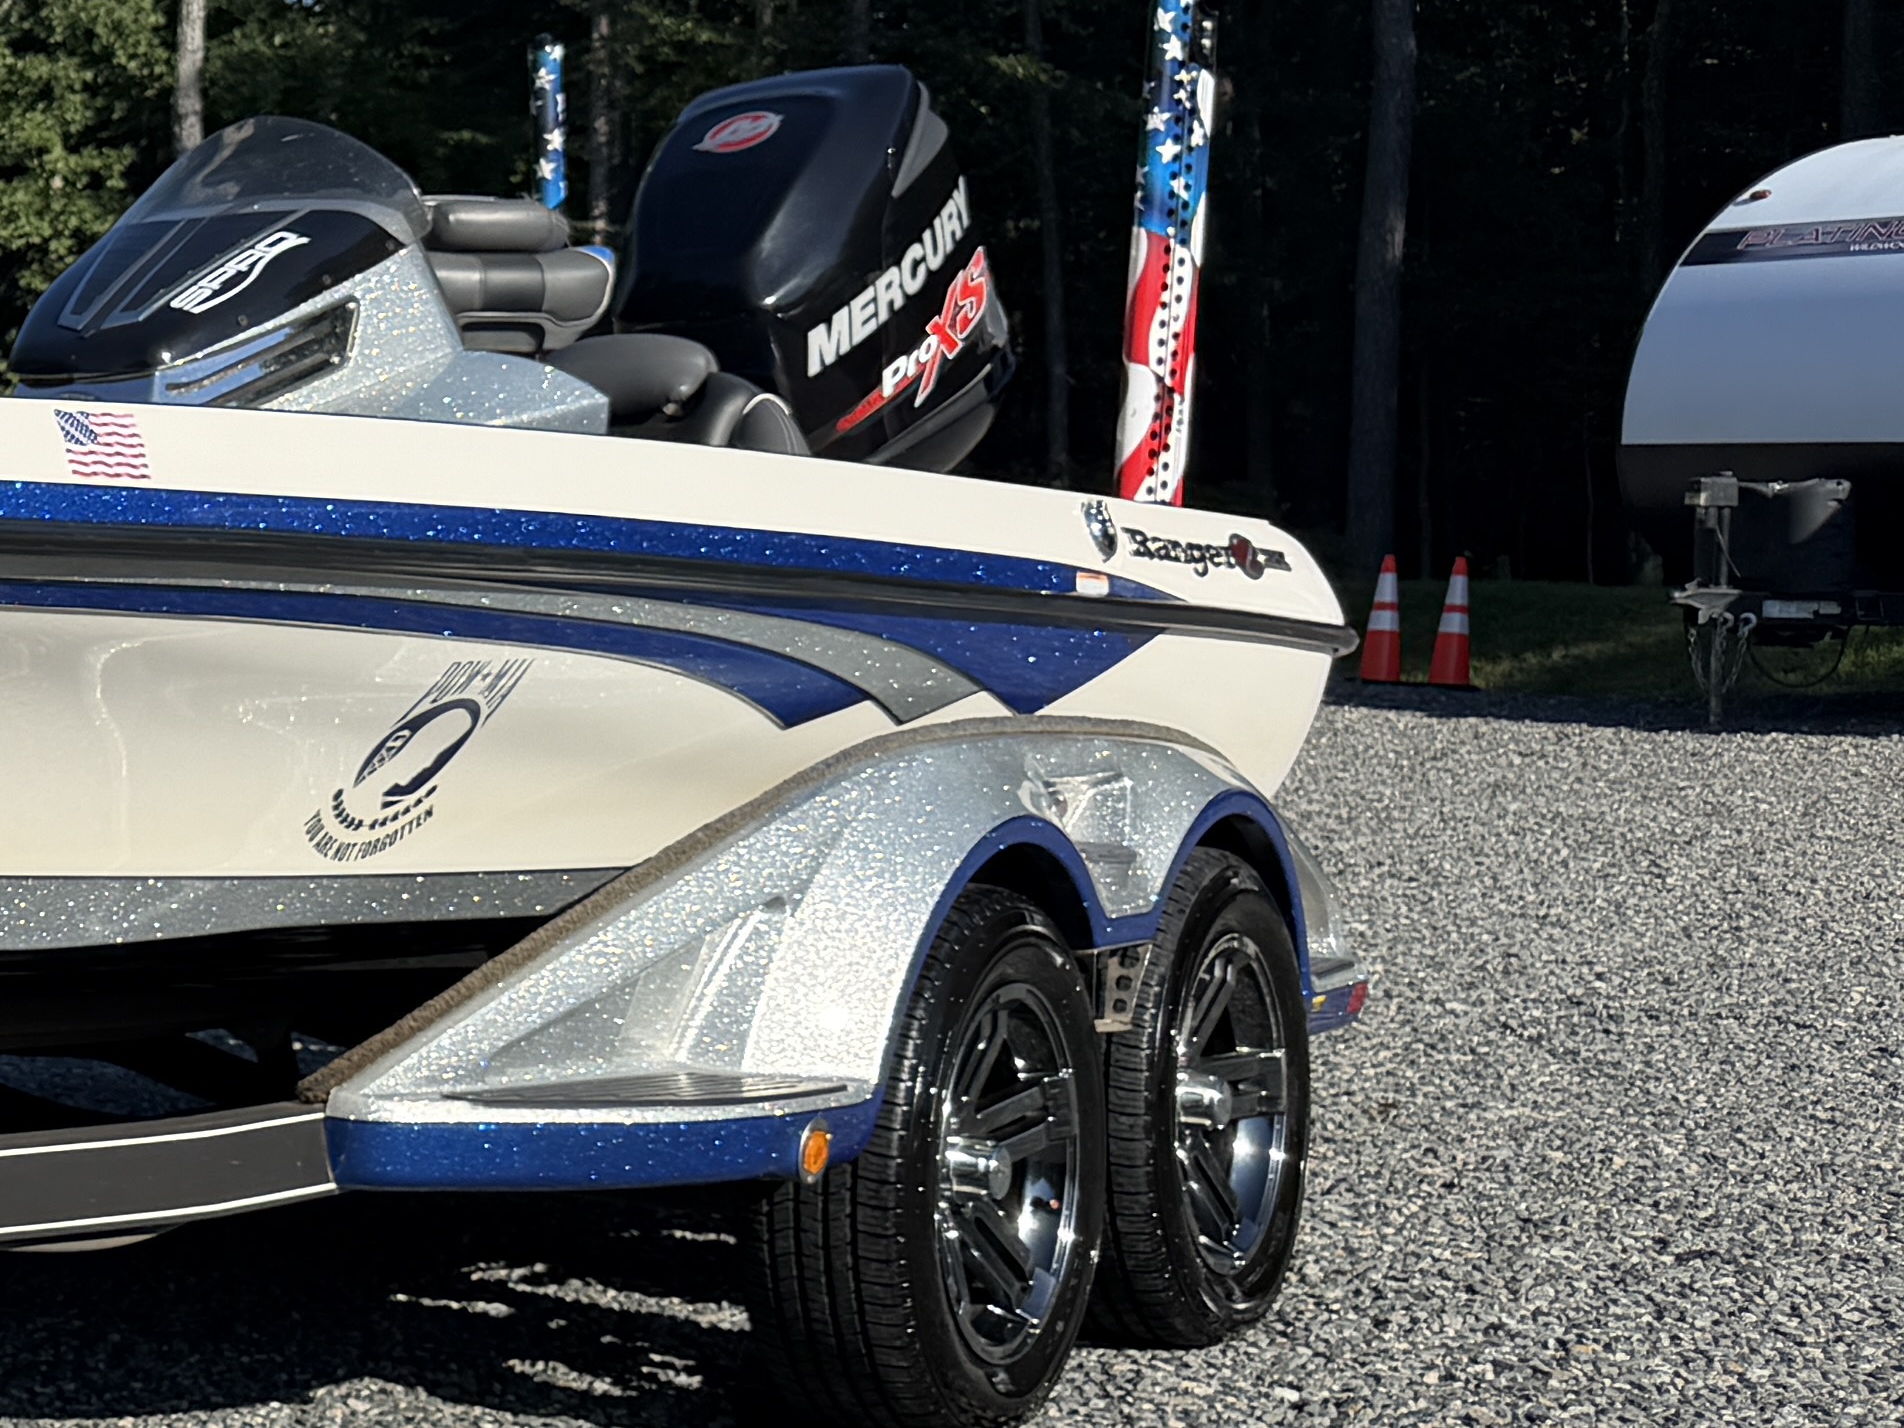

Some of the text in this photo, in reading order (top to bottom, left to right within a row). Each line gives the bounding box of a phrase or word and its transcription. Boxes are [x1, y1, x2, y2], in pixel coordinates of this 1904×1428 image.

[806, 174, 972, 378] MERCURY
[303, 804, 434, 862] YOU ARE NOT FORGOTTEN
